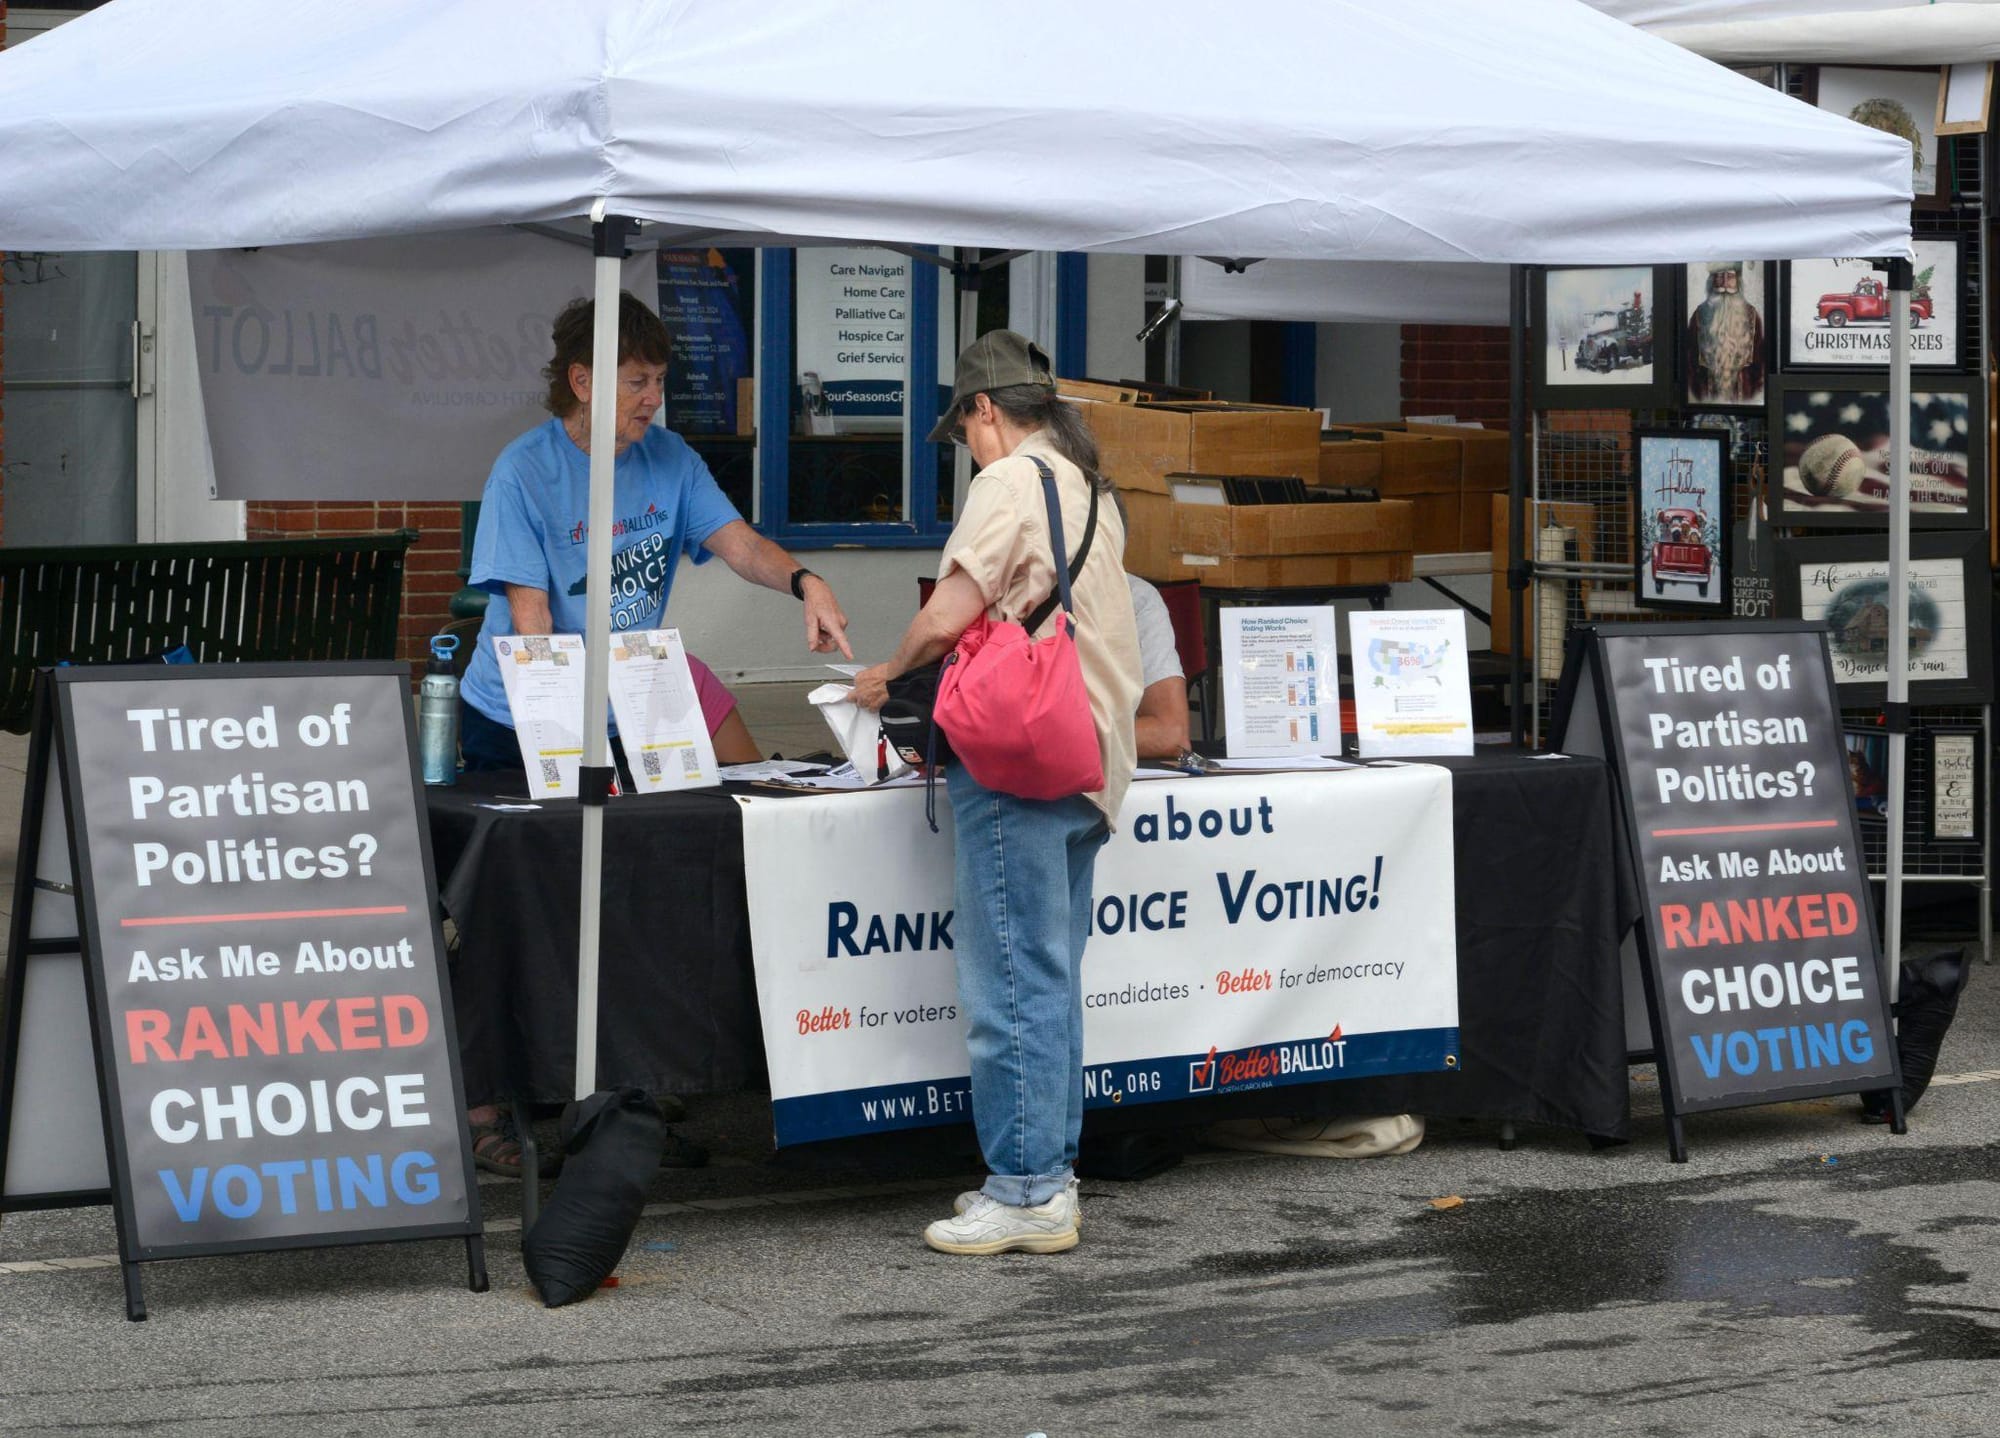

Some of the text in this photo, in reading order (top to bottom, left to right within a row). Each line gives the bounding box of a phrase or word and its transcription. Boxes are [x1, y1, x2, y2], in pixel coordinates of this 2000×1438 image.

[830, 264, 904, 278] Care Navigati
[843, 286, 905, 298] Home Care
[835, 307, 886, 320] Palliative
[837, 352, 904, 364] Grief Service
[838, 330, 905, 343] Hospice Car
[1805, 331, 1943, 350] CHRISTMAS REES
[1931, 462, 1950, 475] OUT
[1917, 490, 1932, 503] THE
[611, 531, 664, 577] NKED
[611, 555, 667, 607] HOICE
[1732, 577, 1770, 588] CHOP IT
[1732, 588, 1773, 599] LIKE IT'S
[1811, 565, 1839, 592] Life
[1732, 599, 1770, 617] HOT
[1643, 653, 1793, 695] Tired of
[127, 702, 351, 752] Tired of
[1650, 710, 1808, 750] Partisan
[129, 773, 370, 820] Partisan
[1656, 761, 1816, 804] Politics?
[1134, 794, 1274, 844] about
[133, 833, 378, 888] Politics?
[1659, 846, 1845, 883] Ask Me About
[827, 901, 955, 958] RANK
[1088, 890, 1188, 936] OICE
[1659, 892, 1858, 950] RANKED
[127, 937, 415, 983] Ask Me About
[796, 961, 1405, 1036] Better for voters candidates Better for democracy
[1681, 956, 1864, 1015] CHOICE
[125, 994, 429, 1064] RANKED
[1691, 1020, 1875, 1079] VOTING
[1219, 1040, 1347, 1085] BetterBALLOT
[150, 1073, 430, 1144] CHOICE
[1240, 1081, 1273, 1093] CAROLINA
[158, 1151, 441, 1223] VOTING
